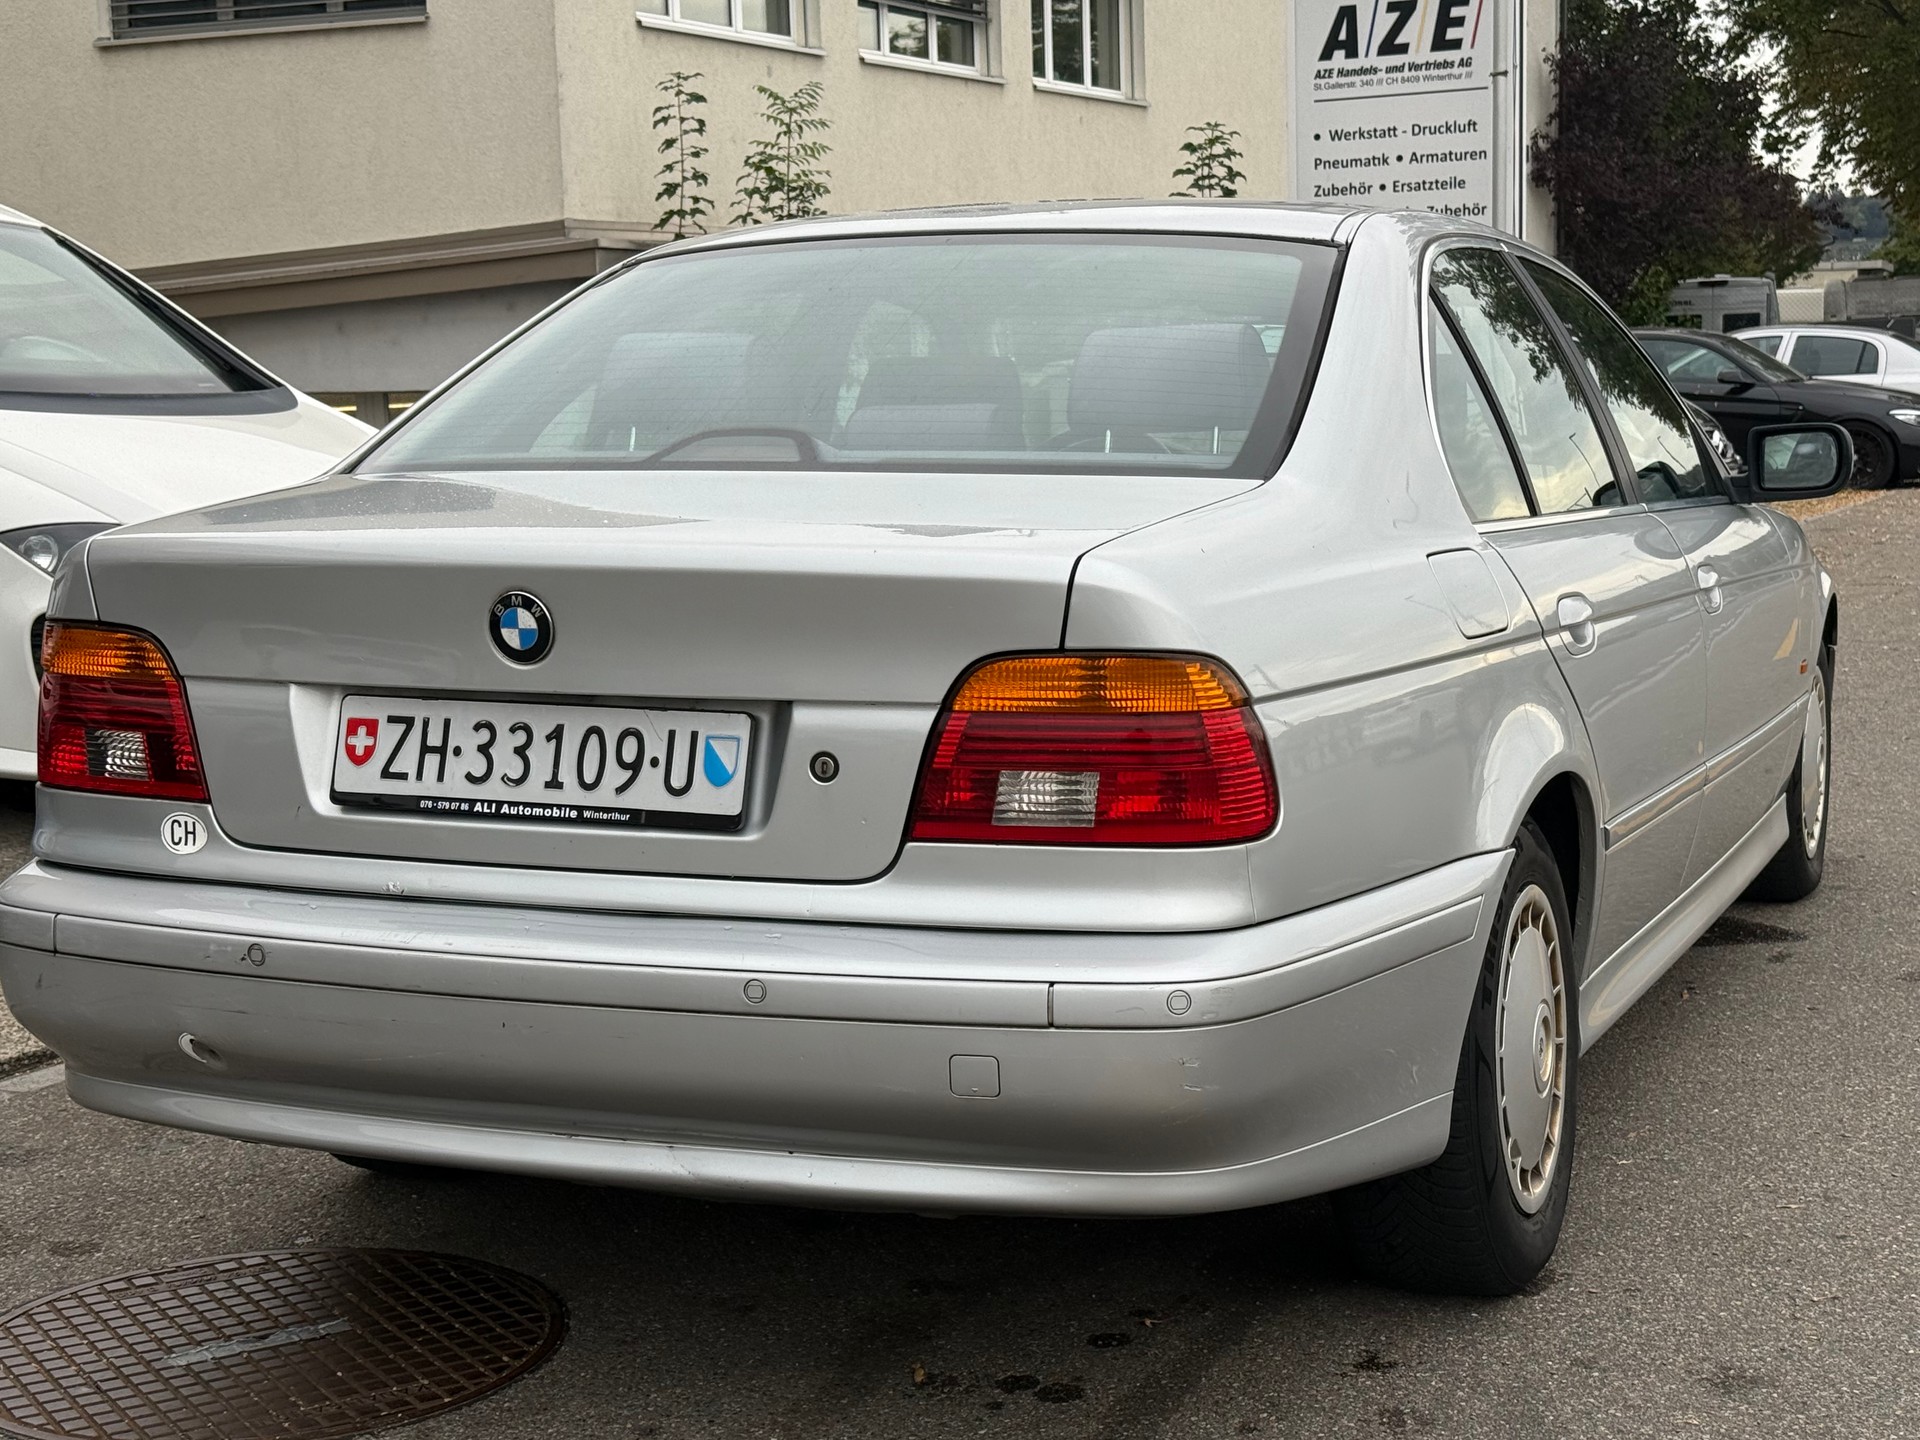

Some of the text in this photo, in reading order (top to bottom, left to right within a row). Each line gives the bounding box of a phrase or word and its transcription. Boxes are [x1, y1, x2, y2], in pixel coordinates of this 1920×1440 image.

[1314, 56, 1473, 80] AZE Handels- und Vertriebs AG
[1360, 79, 1374, 87] 340
[1385, 76, 1399, 85] CH
[1400, 75, 1421, 84] 8409
[1422, 71, 1464, 83] Winterthur
[1329, 125, 1398, 142] Werkstatt
[1411, 119, 1478, 137] Druckluft
[1314, 150, 1487, 170] Pneumatik Armaturen
[1314, 176, 1466, 198] Zubehör Ersatzteile
[494, 595, 544, 618] BMW
[473, 801, 496, 813] ALI
[500, 803, 578, 818] Automobile
[582, 810, 630, 821] Winterthur
[171, 819, 197, 847] CH
